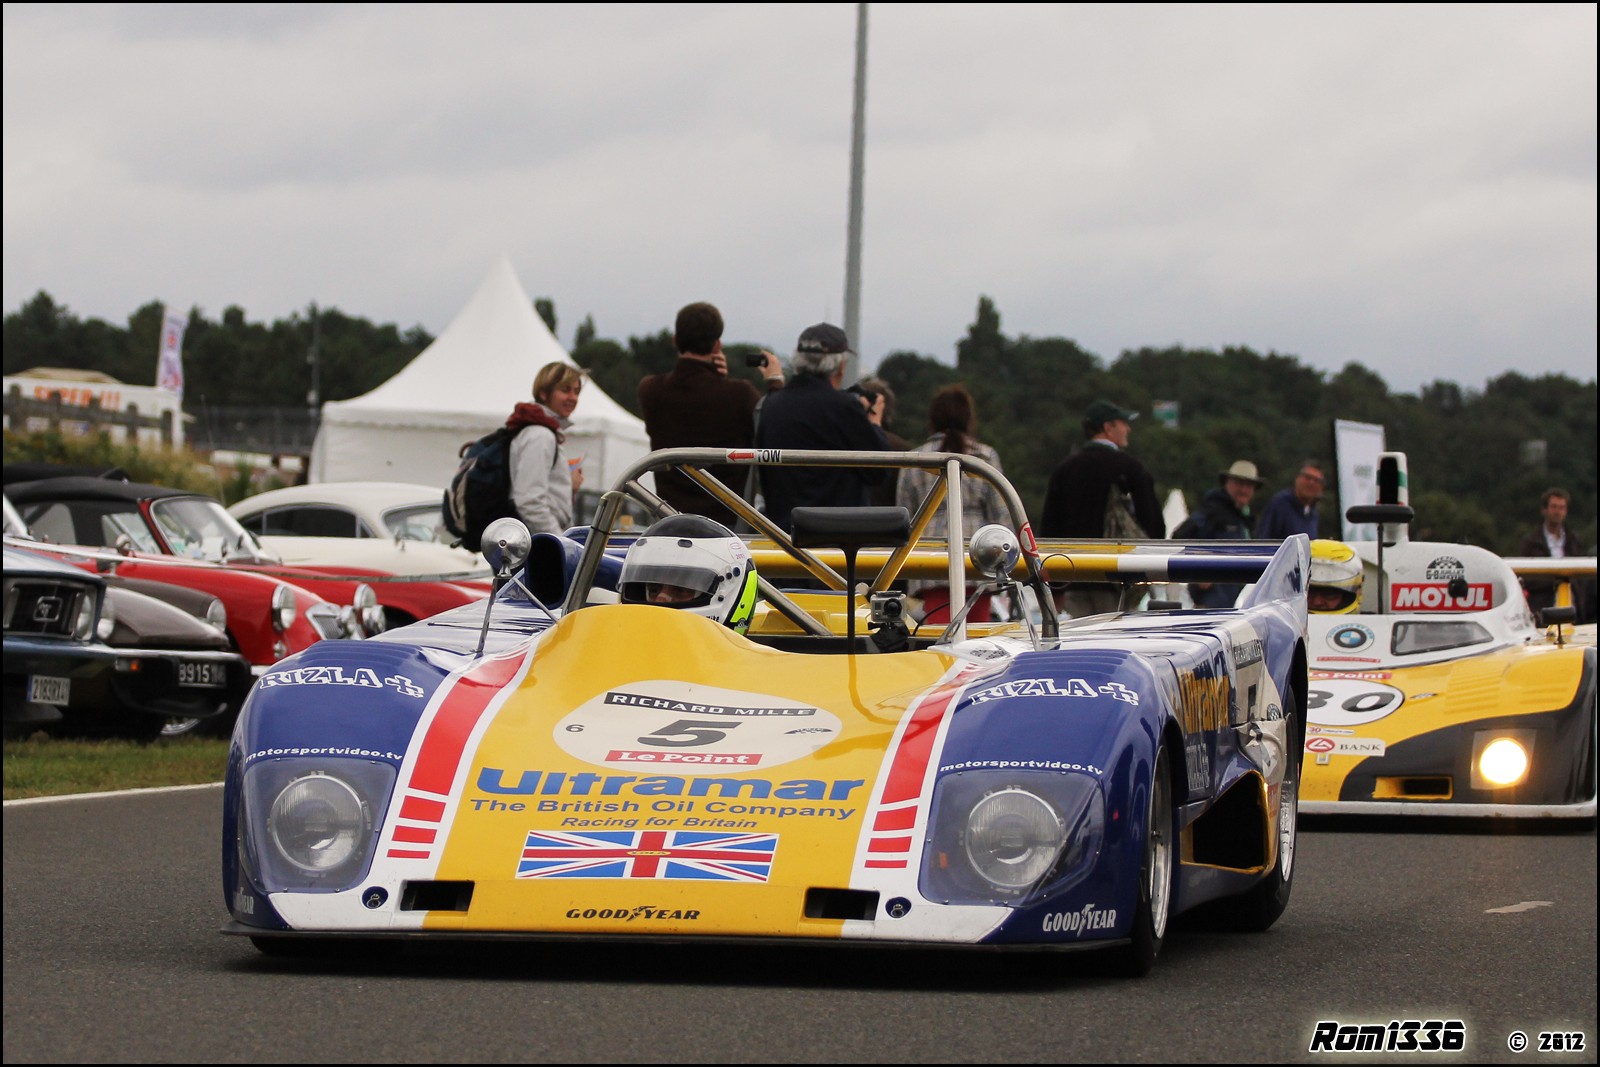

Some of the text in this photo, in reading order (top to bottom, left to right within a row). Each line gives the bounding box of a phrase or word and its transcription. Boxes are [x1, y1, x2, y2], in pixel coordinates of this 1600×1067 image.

[757, 450, 781, 463] TOW
[1395, 586, 1489, 608] MOTUL
[1332, 671, 1384, 679] Point
[612, 694, 812, 716] RICHARD MILLE
[565, 723, 585, 733] 6
[637, 719, 743, 747] 5
[245, 747, 403, 764] motorsportvideo.tv
[617, 751, 750, 763] Le Point
[940, 760, 1104, 776] motorsportvideo.tv
[476, 767, 865, 800] Ultramar
[470, 799, 856, 820] The British Oil Company
[561, 817, 758, 829] Racing for Britain
